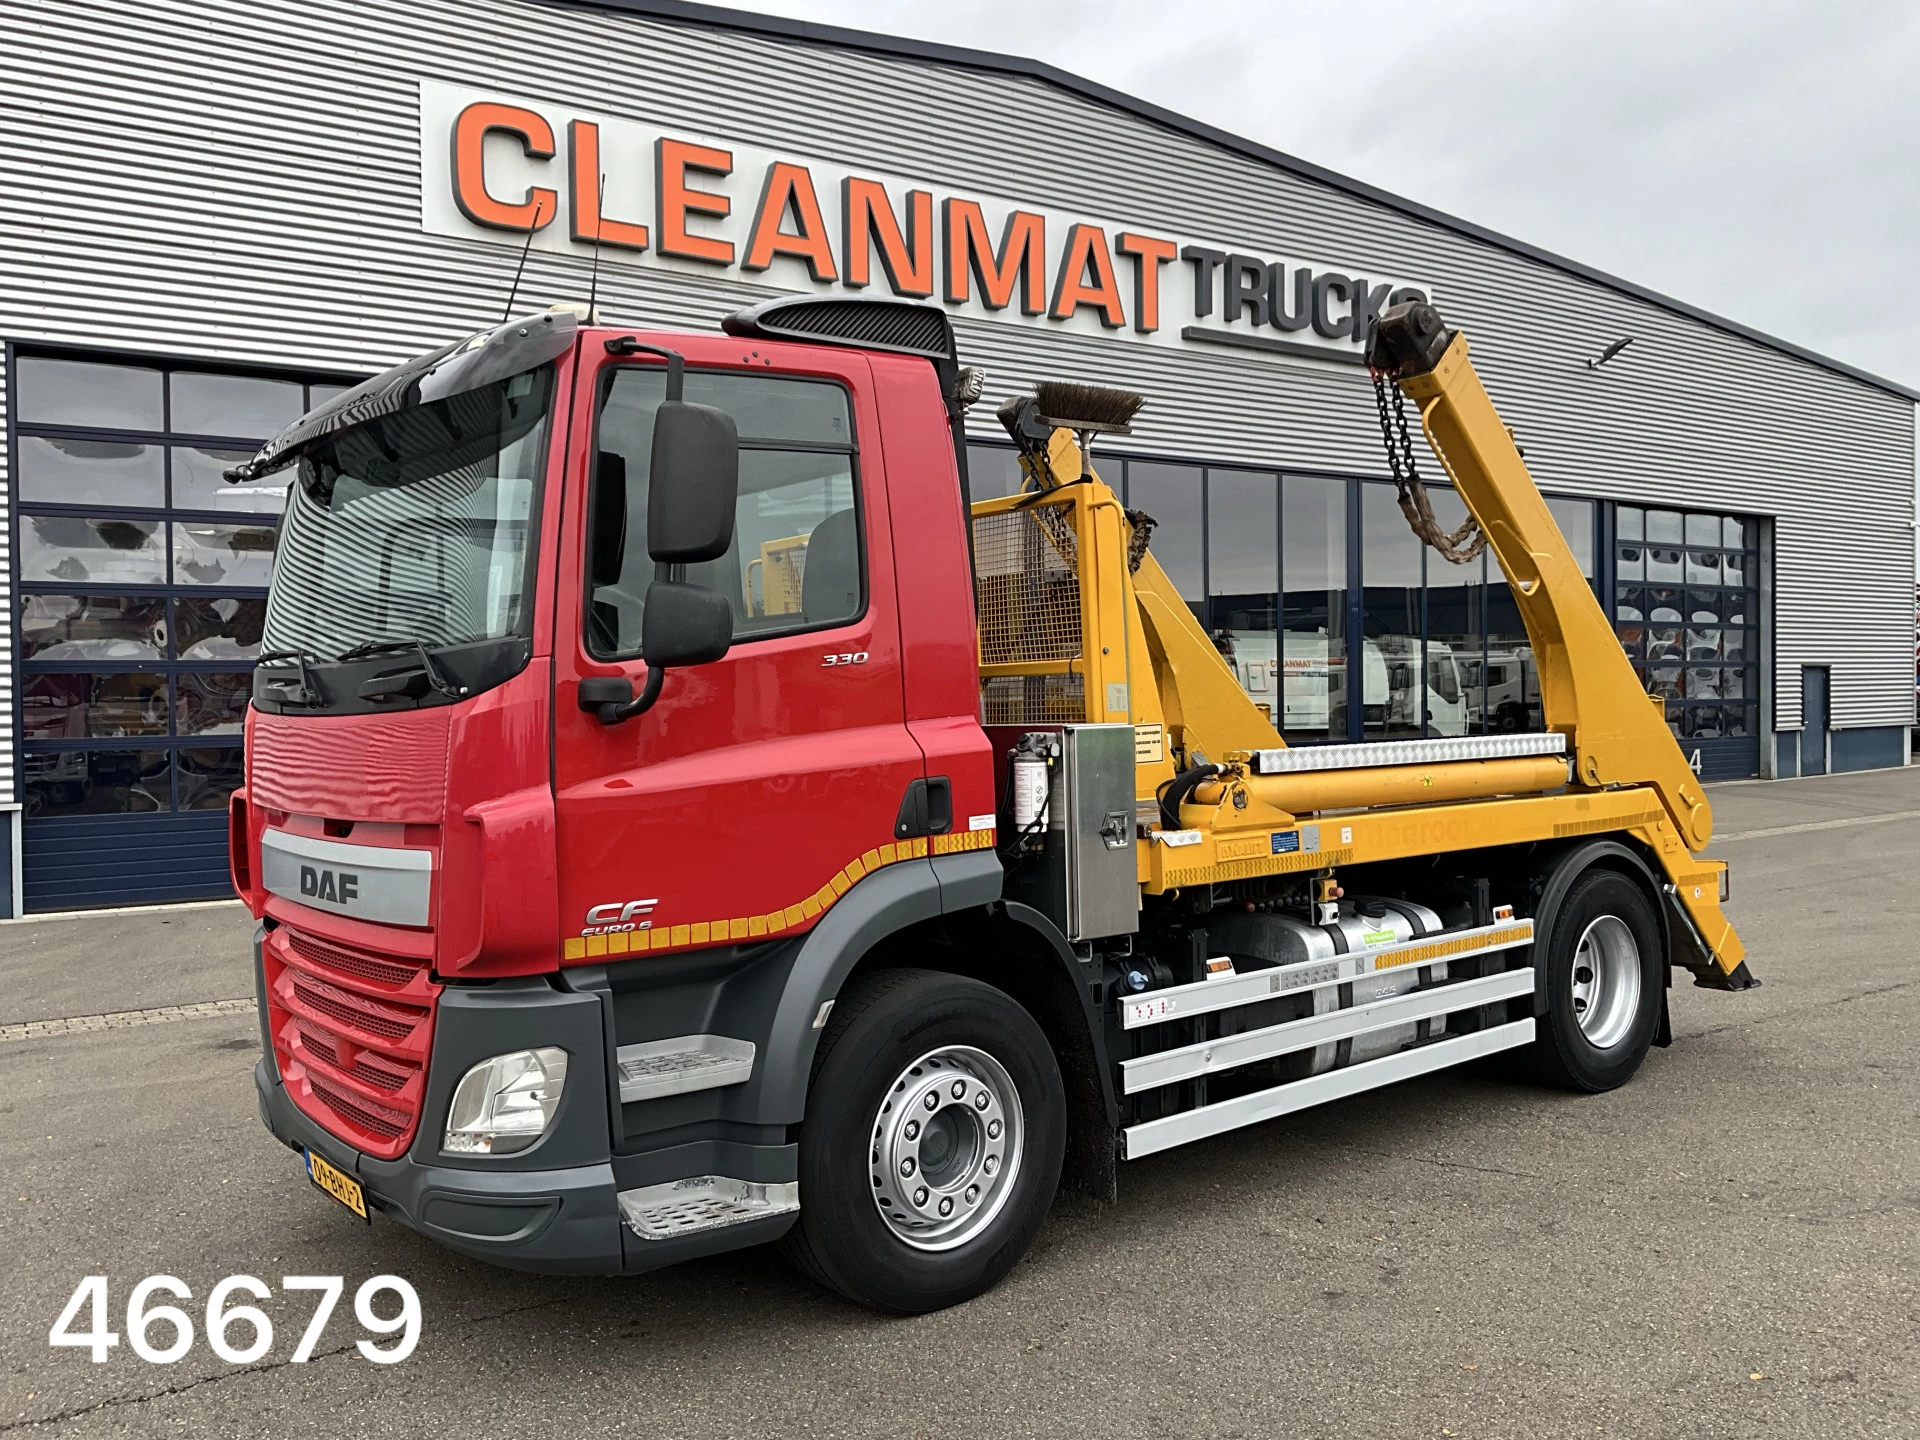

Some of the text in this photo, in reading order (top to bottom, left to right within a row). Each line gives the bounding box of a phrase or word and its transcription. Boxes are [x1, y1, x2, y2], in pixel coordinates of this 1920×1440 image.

[450, 101, 1426, 342] CLEANMAT TRUCK
[821, 652, 869, 667] 330
[1270, 659, 1311, 668] CANMAT
[1688, 748, 1702, 775] 4
[300, 865, 359, 905] DAF
[586, 898, 659, 925] CF
[581, 920, 652, 937] EURO 6
